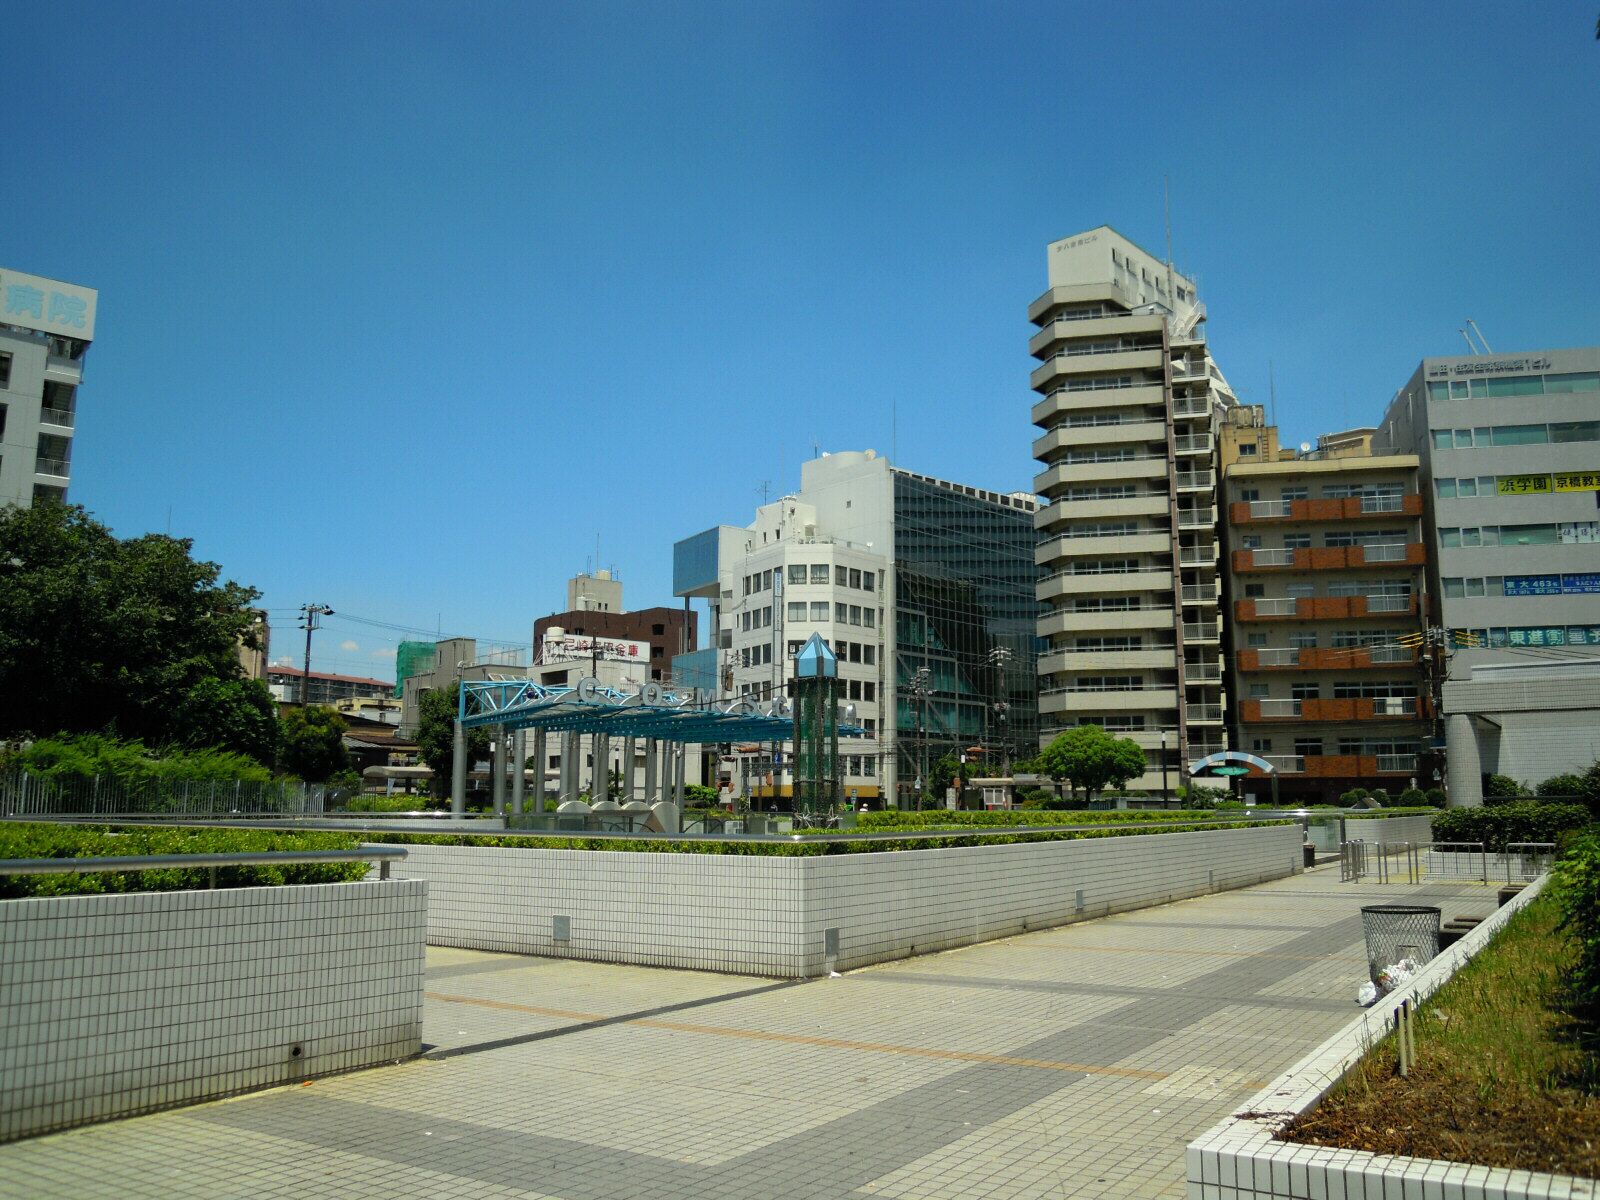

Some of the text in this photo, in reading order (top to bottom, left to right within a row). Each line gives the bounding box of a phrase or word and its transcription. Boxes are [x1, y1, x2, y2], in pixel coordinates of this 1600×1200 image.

[5, 284, 87, 328] 病院
[1501, 477, 1546, 492] 浜学園
